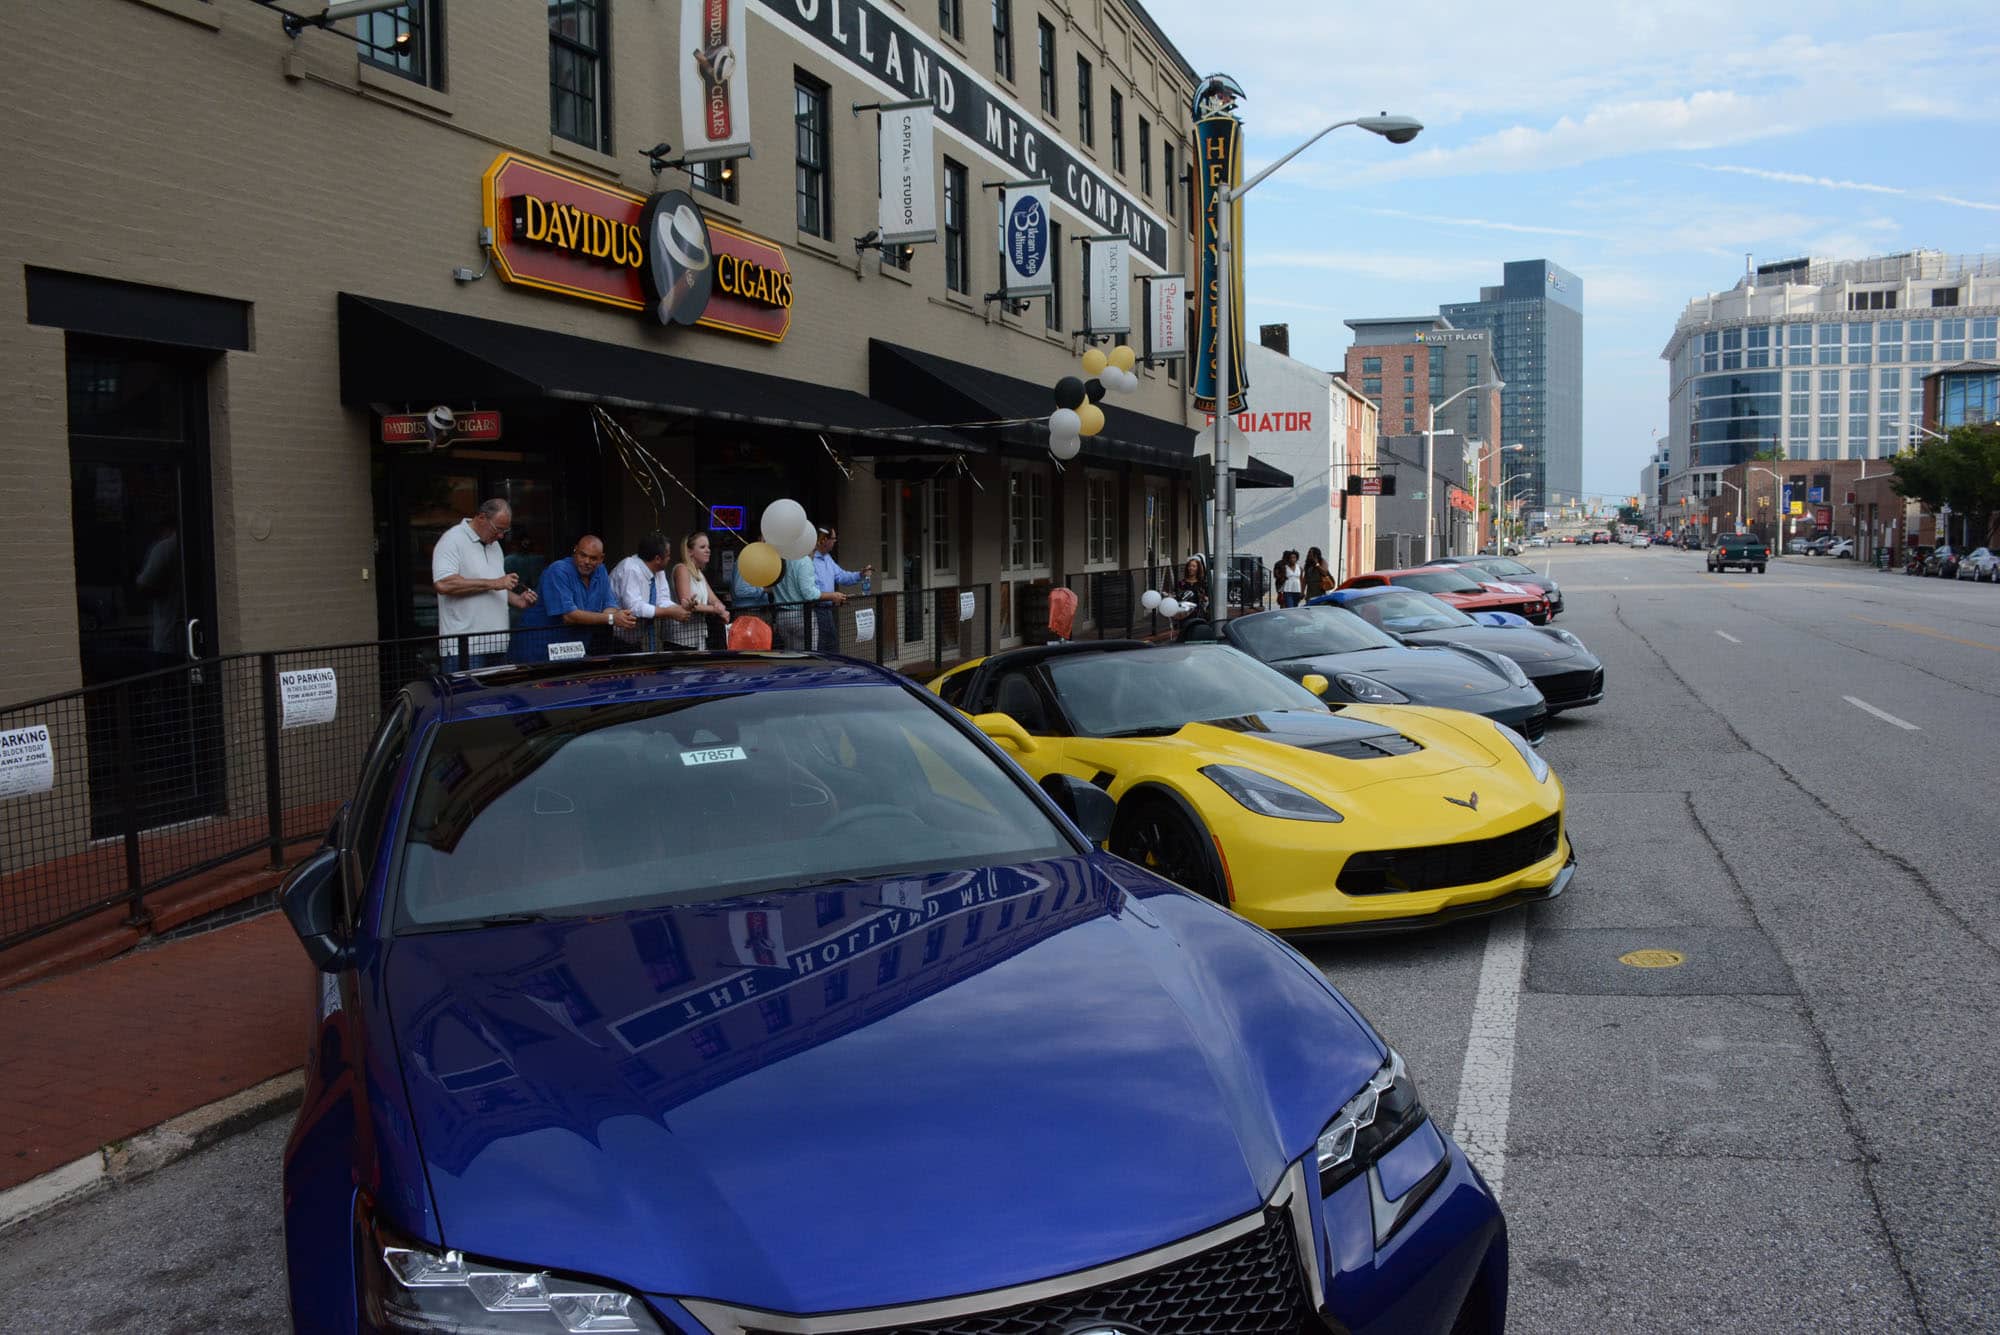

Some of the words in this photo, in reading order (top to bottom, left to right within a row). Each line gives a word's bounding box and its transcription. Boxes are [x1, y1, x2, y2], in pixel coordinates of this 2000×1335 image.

[711, 85, 726, 136] CIGARS
[902, 115, 912, 163] CAPITAL
[902, 175, 913, 226] STUDIOS
[1067, 164, 1152, 252] COMPANY
[1014, 211, 1029, 266] Baltimore
[1027, 202, 1040, 252] Bikram
[525, 194, 644, 268] DAVIDUS
[717, 254, 794, 309] CIGARS
[1026, 252, 1040, 274] Yoga
[1109, 245, 1119, 273] TACK
[1109, 275, 1119, 322] FACTORY
[1425, 334, 1453, 342] HYATT
[1455, 333, 1484, 341] PLACE
[384, 421, 426, 434] DAVIDUS
[457, 418, 497, 432] CIGARS
[1206, 412, 1312, 433] DIATOR
[282, 675, 295, 686] NO
[297, 671, 334, 684] PARKING
[0, 730, 47, 748] ARKING
[2, 748, 24, 758] BLOCK
[24, 744, 44, 753] TODAY
[1, 757, 23, 766] AWAY
[26, 753, 47, 761] ZONE
[689, 749, 735, 763] 17857
